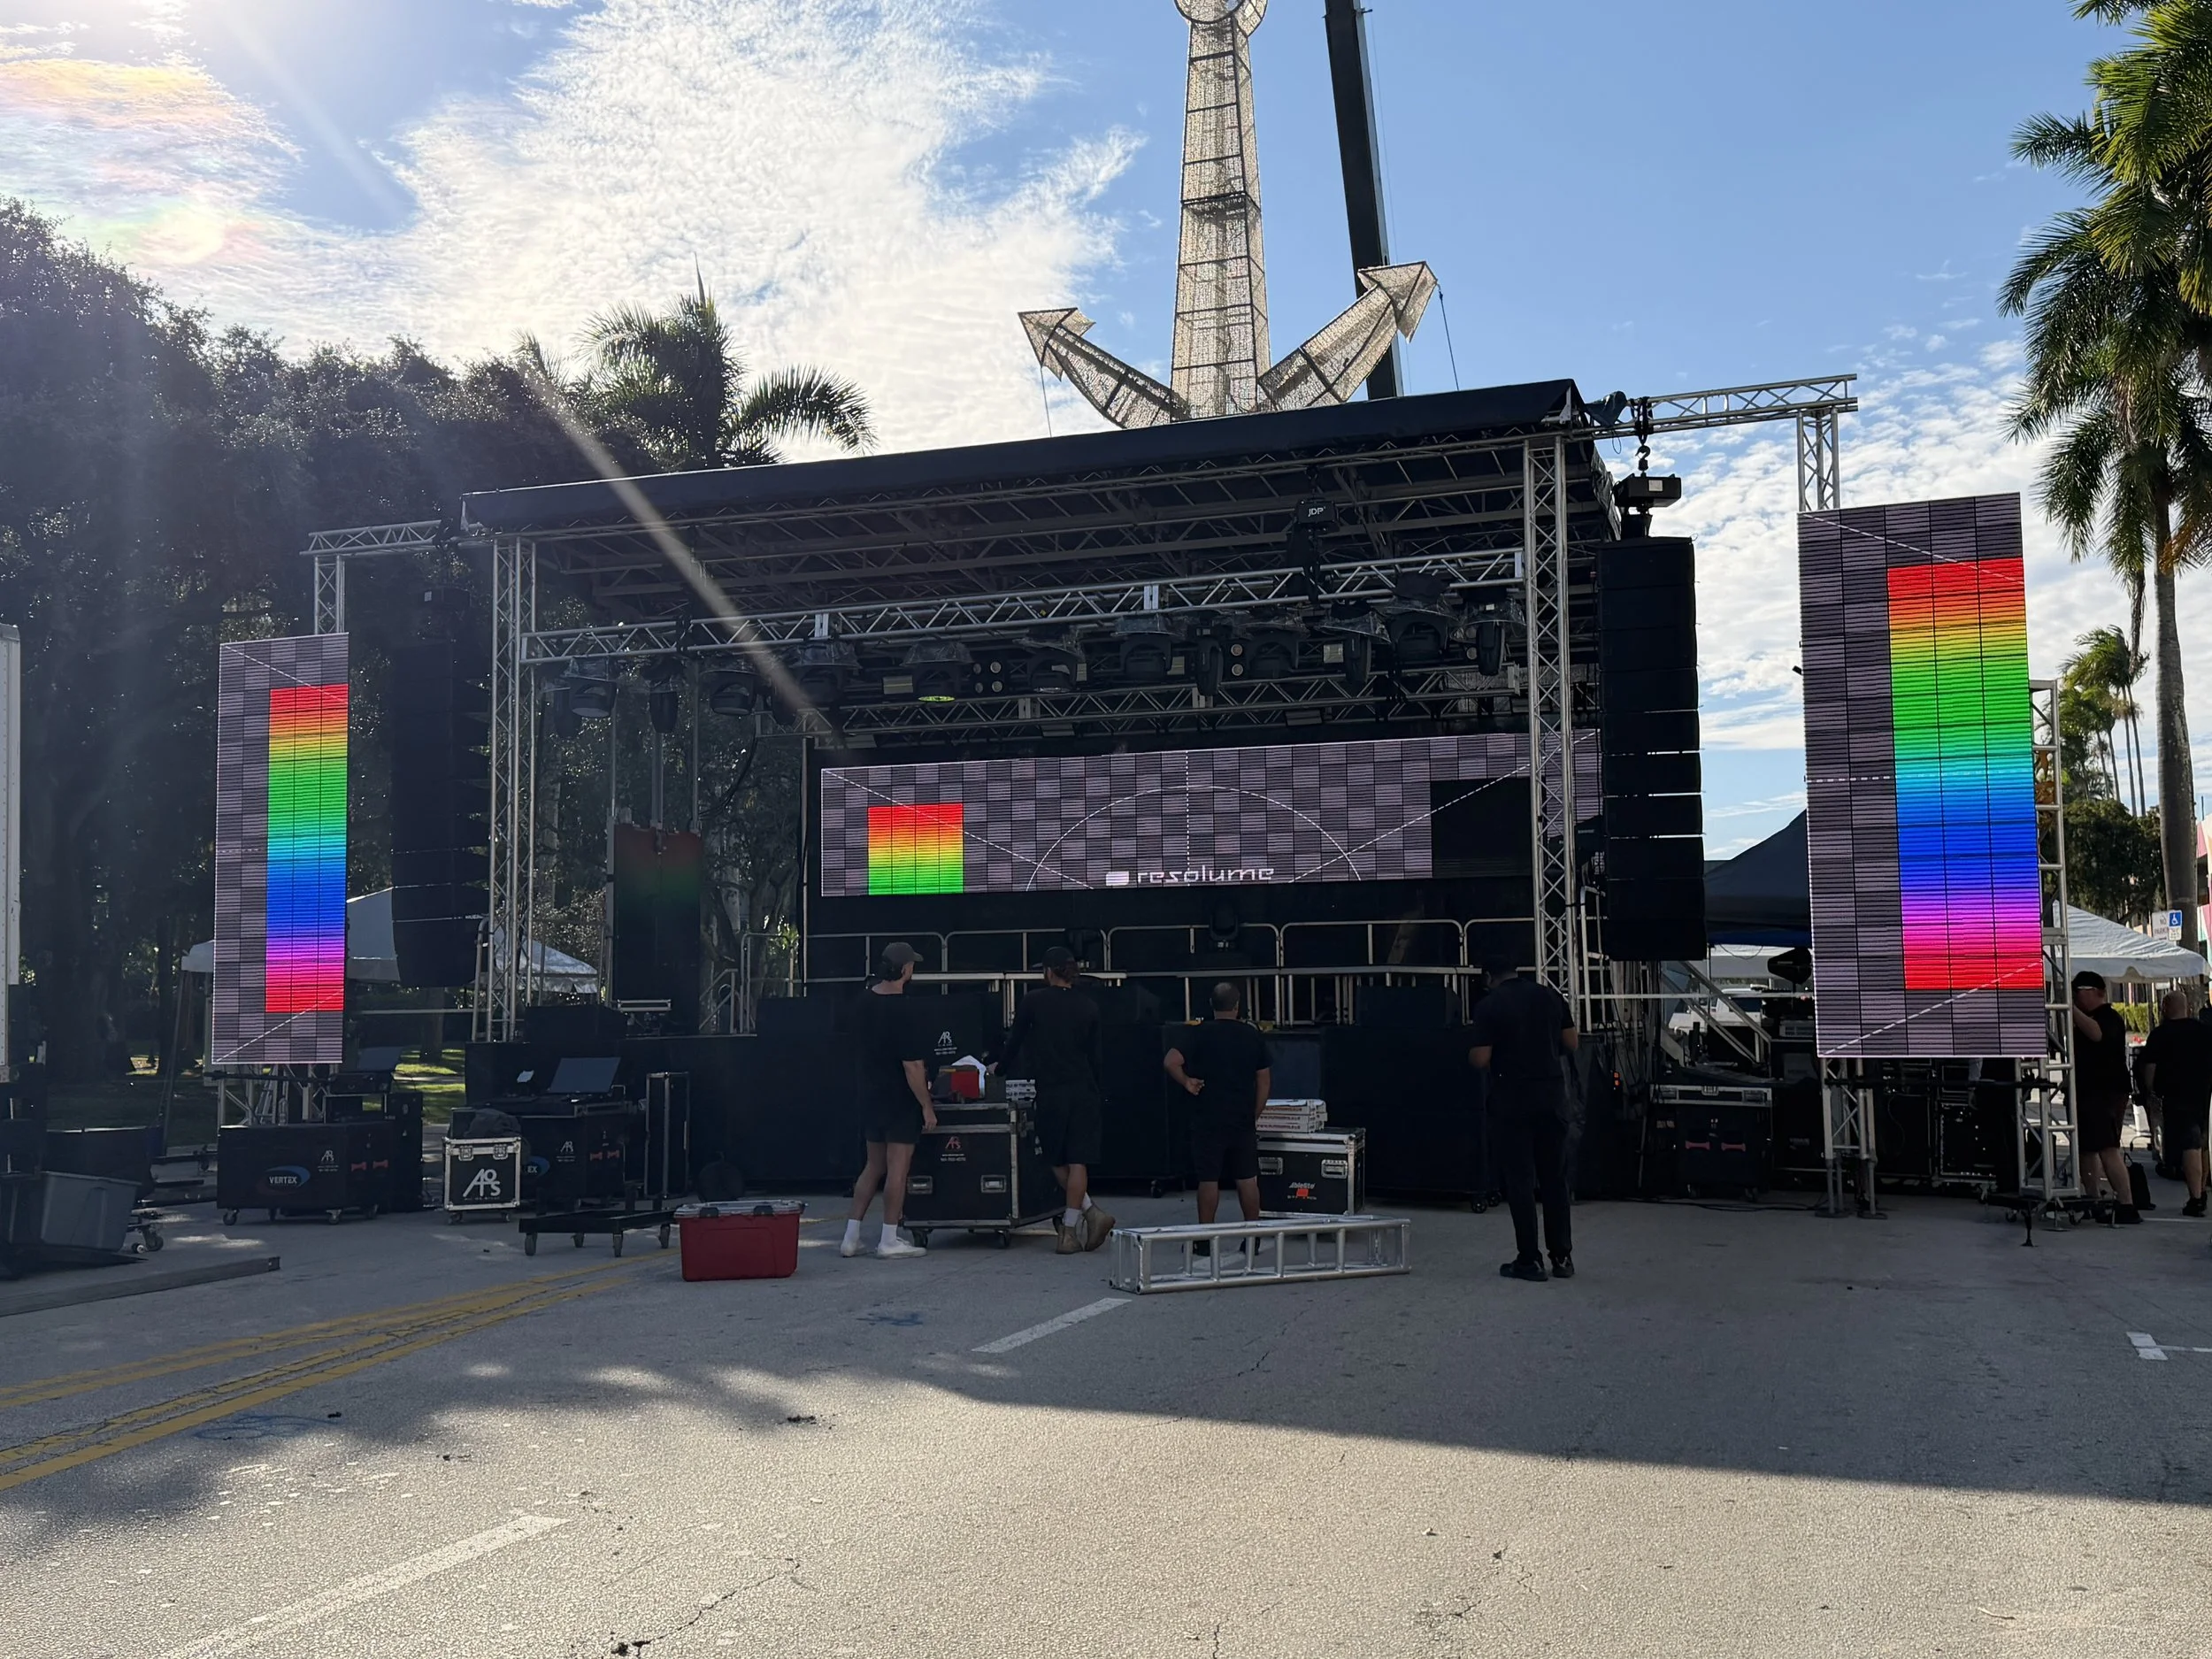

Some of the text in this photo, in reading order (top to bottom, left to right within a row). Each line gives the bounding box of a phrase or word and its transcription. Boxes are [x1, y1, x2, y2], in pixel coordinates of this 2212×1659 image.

[1308, 507, 1325, 518] JDP
[1137, 865, 1274, 884] resolume
[269, 1176, 299, 1185] VERTEX
